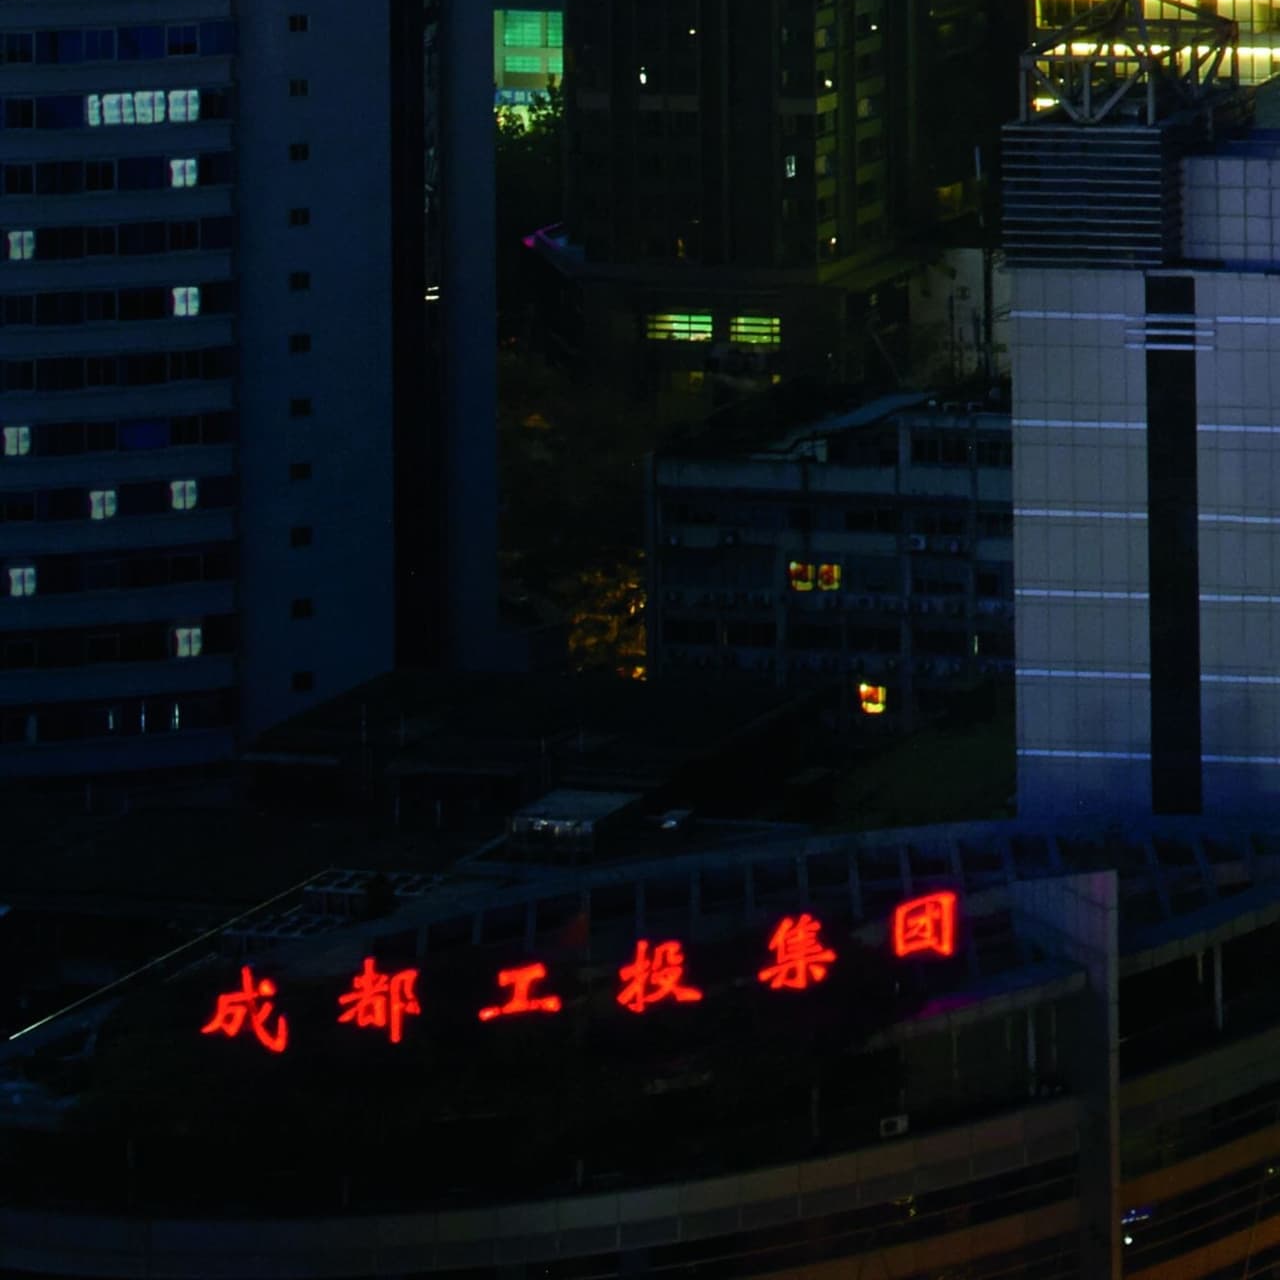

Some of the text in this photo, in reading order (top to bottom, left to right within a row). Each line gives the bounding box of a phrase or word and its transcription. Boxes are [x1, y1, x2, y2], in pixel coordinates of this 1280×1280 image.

[199, 889, 959, 1054] 成都工投集团
